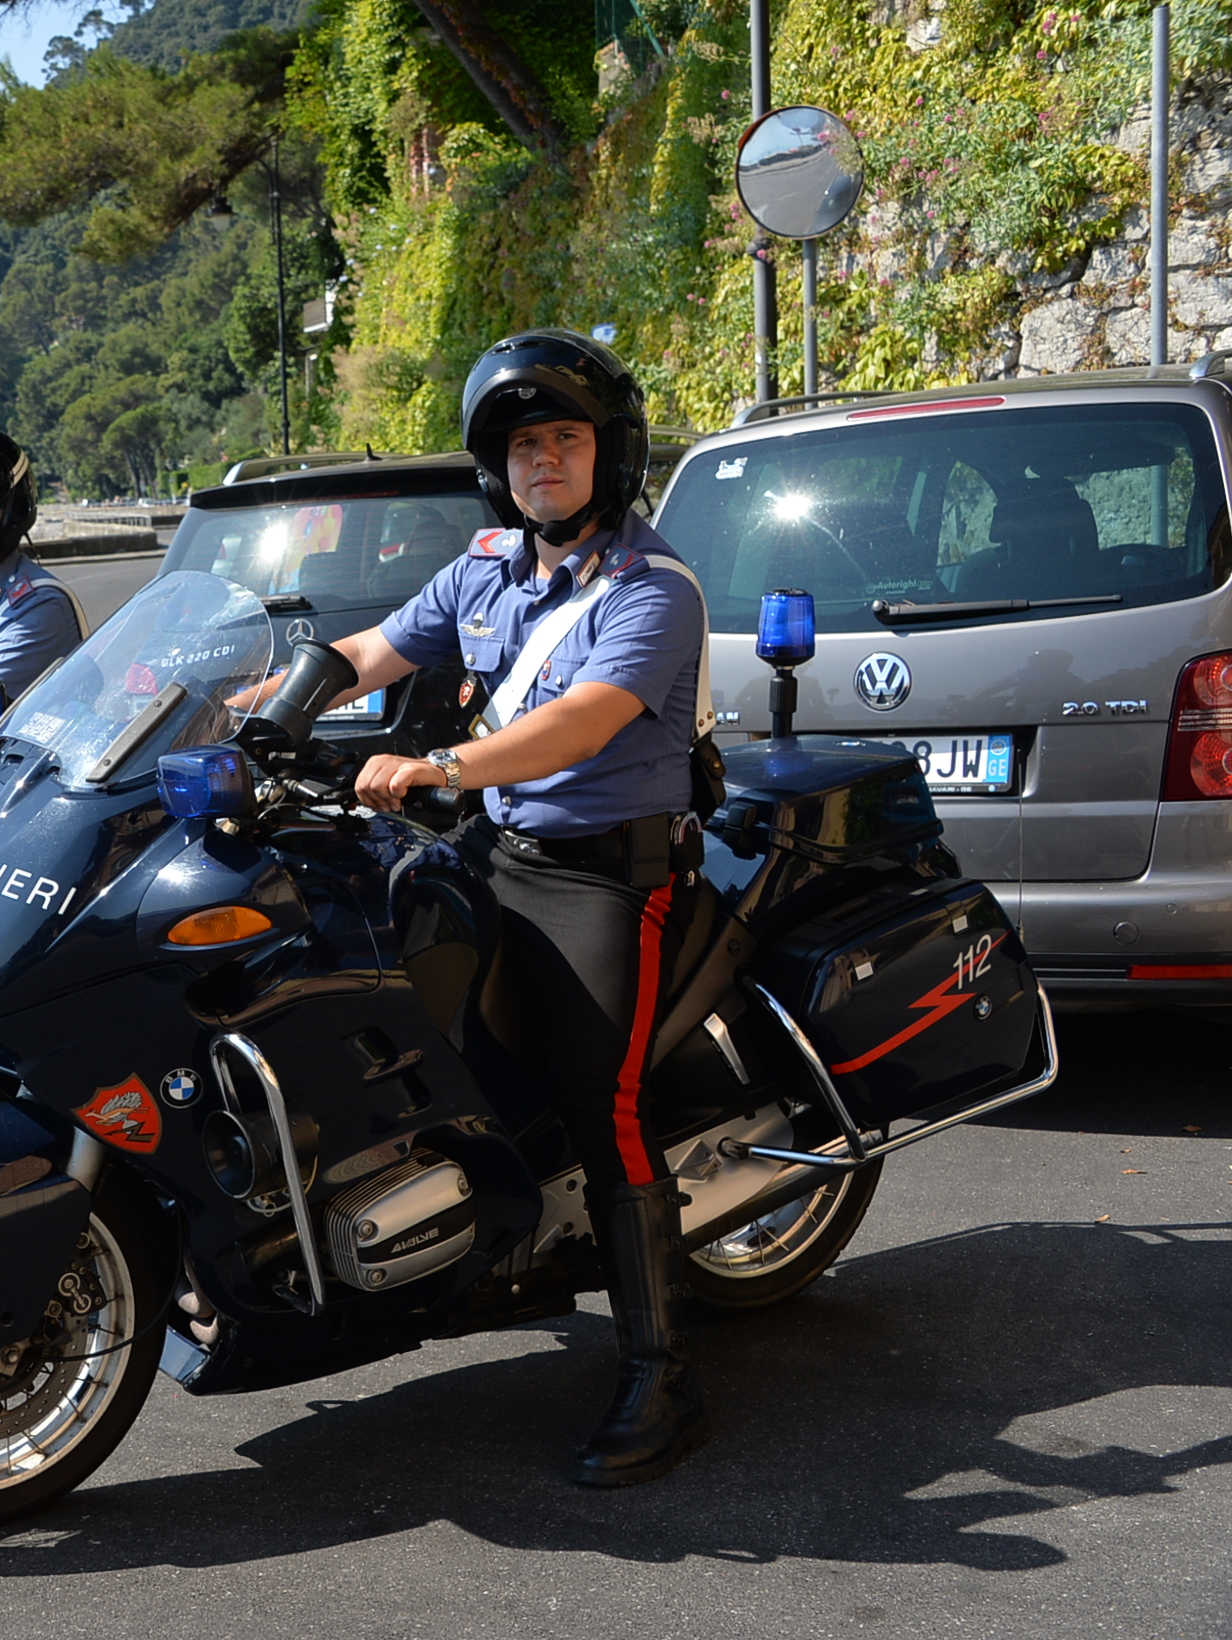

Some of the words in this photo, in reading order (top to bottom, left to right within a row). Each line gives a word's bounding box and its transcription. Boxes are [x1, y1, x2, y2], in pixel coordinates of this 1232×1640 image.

[212, 645, 236, 657] CDI
[1105, 699, 1148, 714] TDI
[988, 759, 1007, 776] GE
[952, 934, 992, 990] 112
